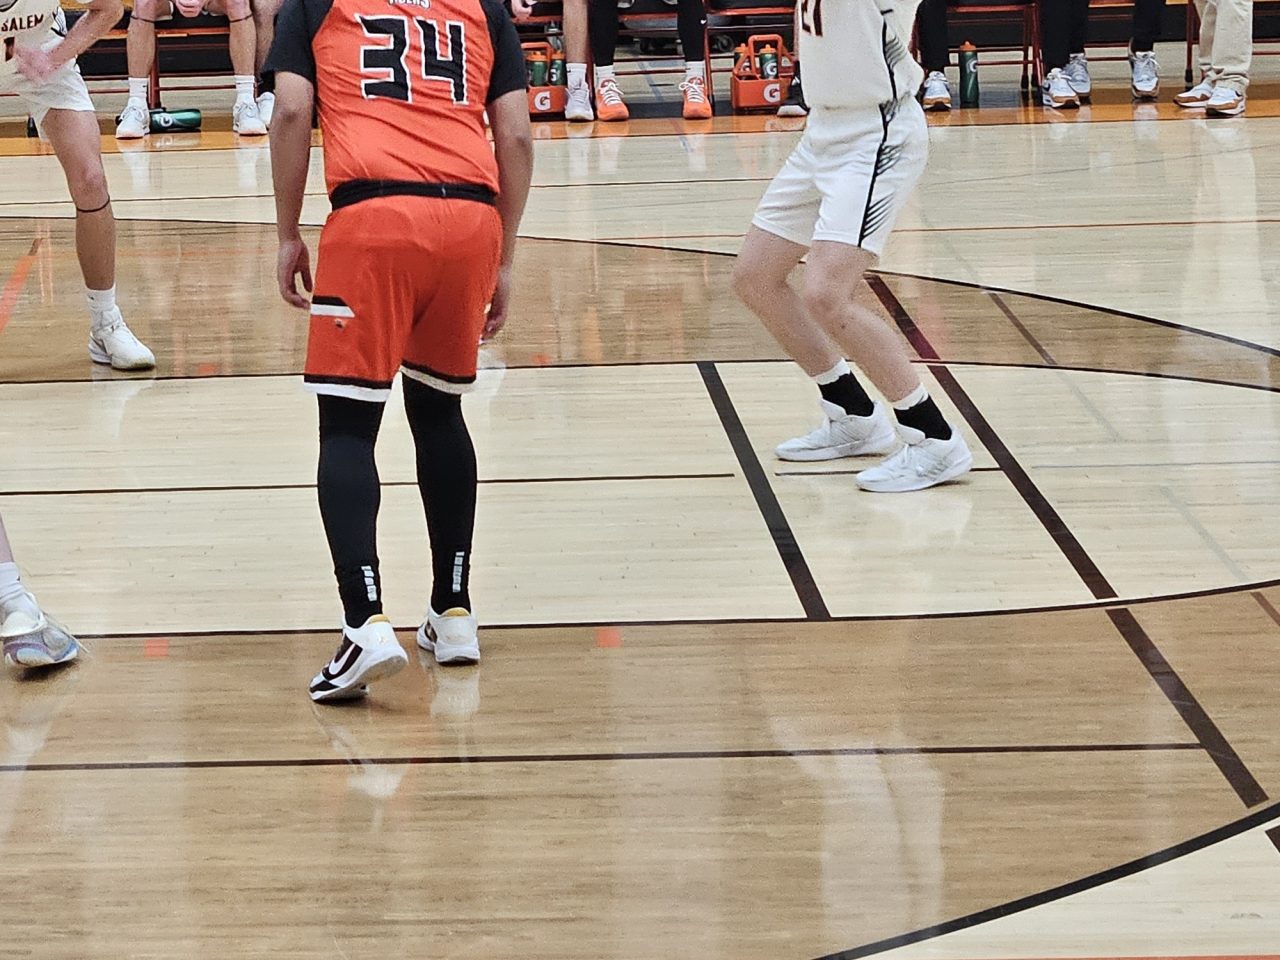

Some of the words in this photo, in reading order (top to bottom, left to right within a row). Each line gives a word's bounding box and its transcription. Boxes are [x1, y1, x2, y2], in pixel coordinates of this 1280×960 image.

[1, 13, 44, 32] SALEM
[353, 13, 468, 105] 34
[534, 91, 551, 111] G
[763, 83, 781, 104] G
